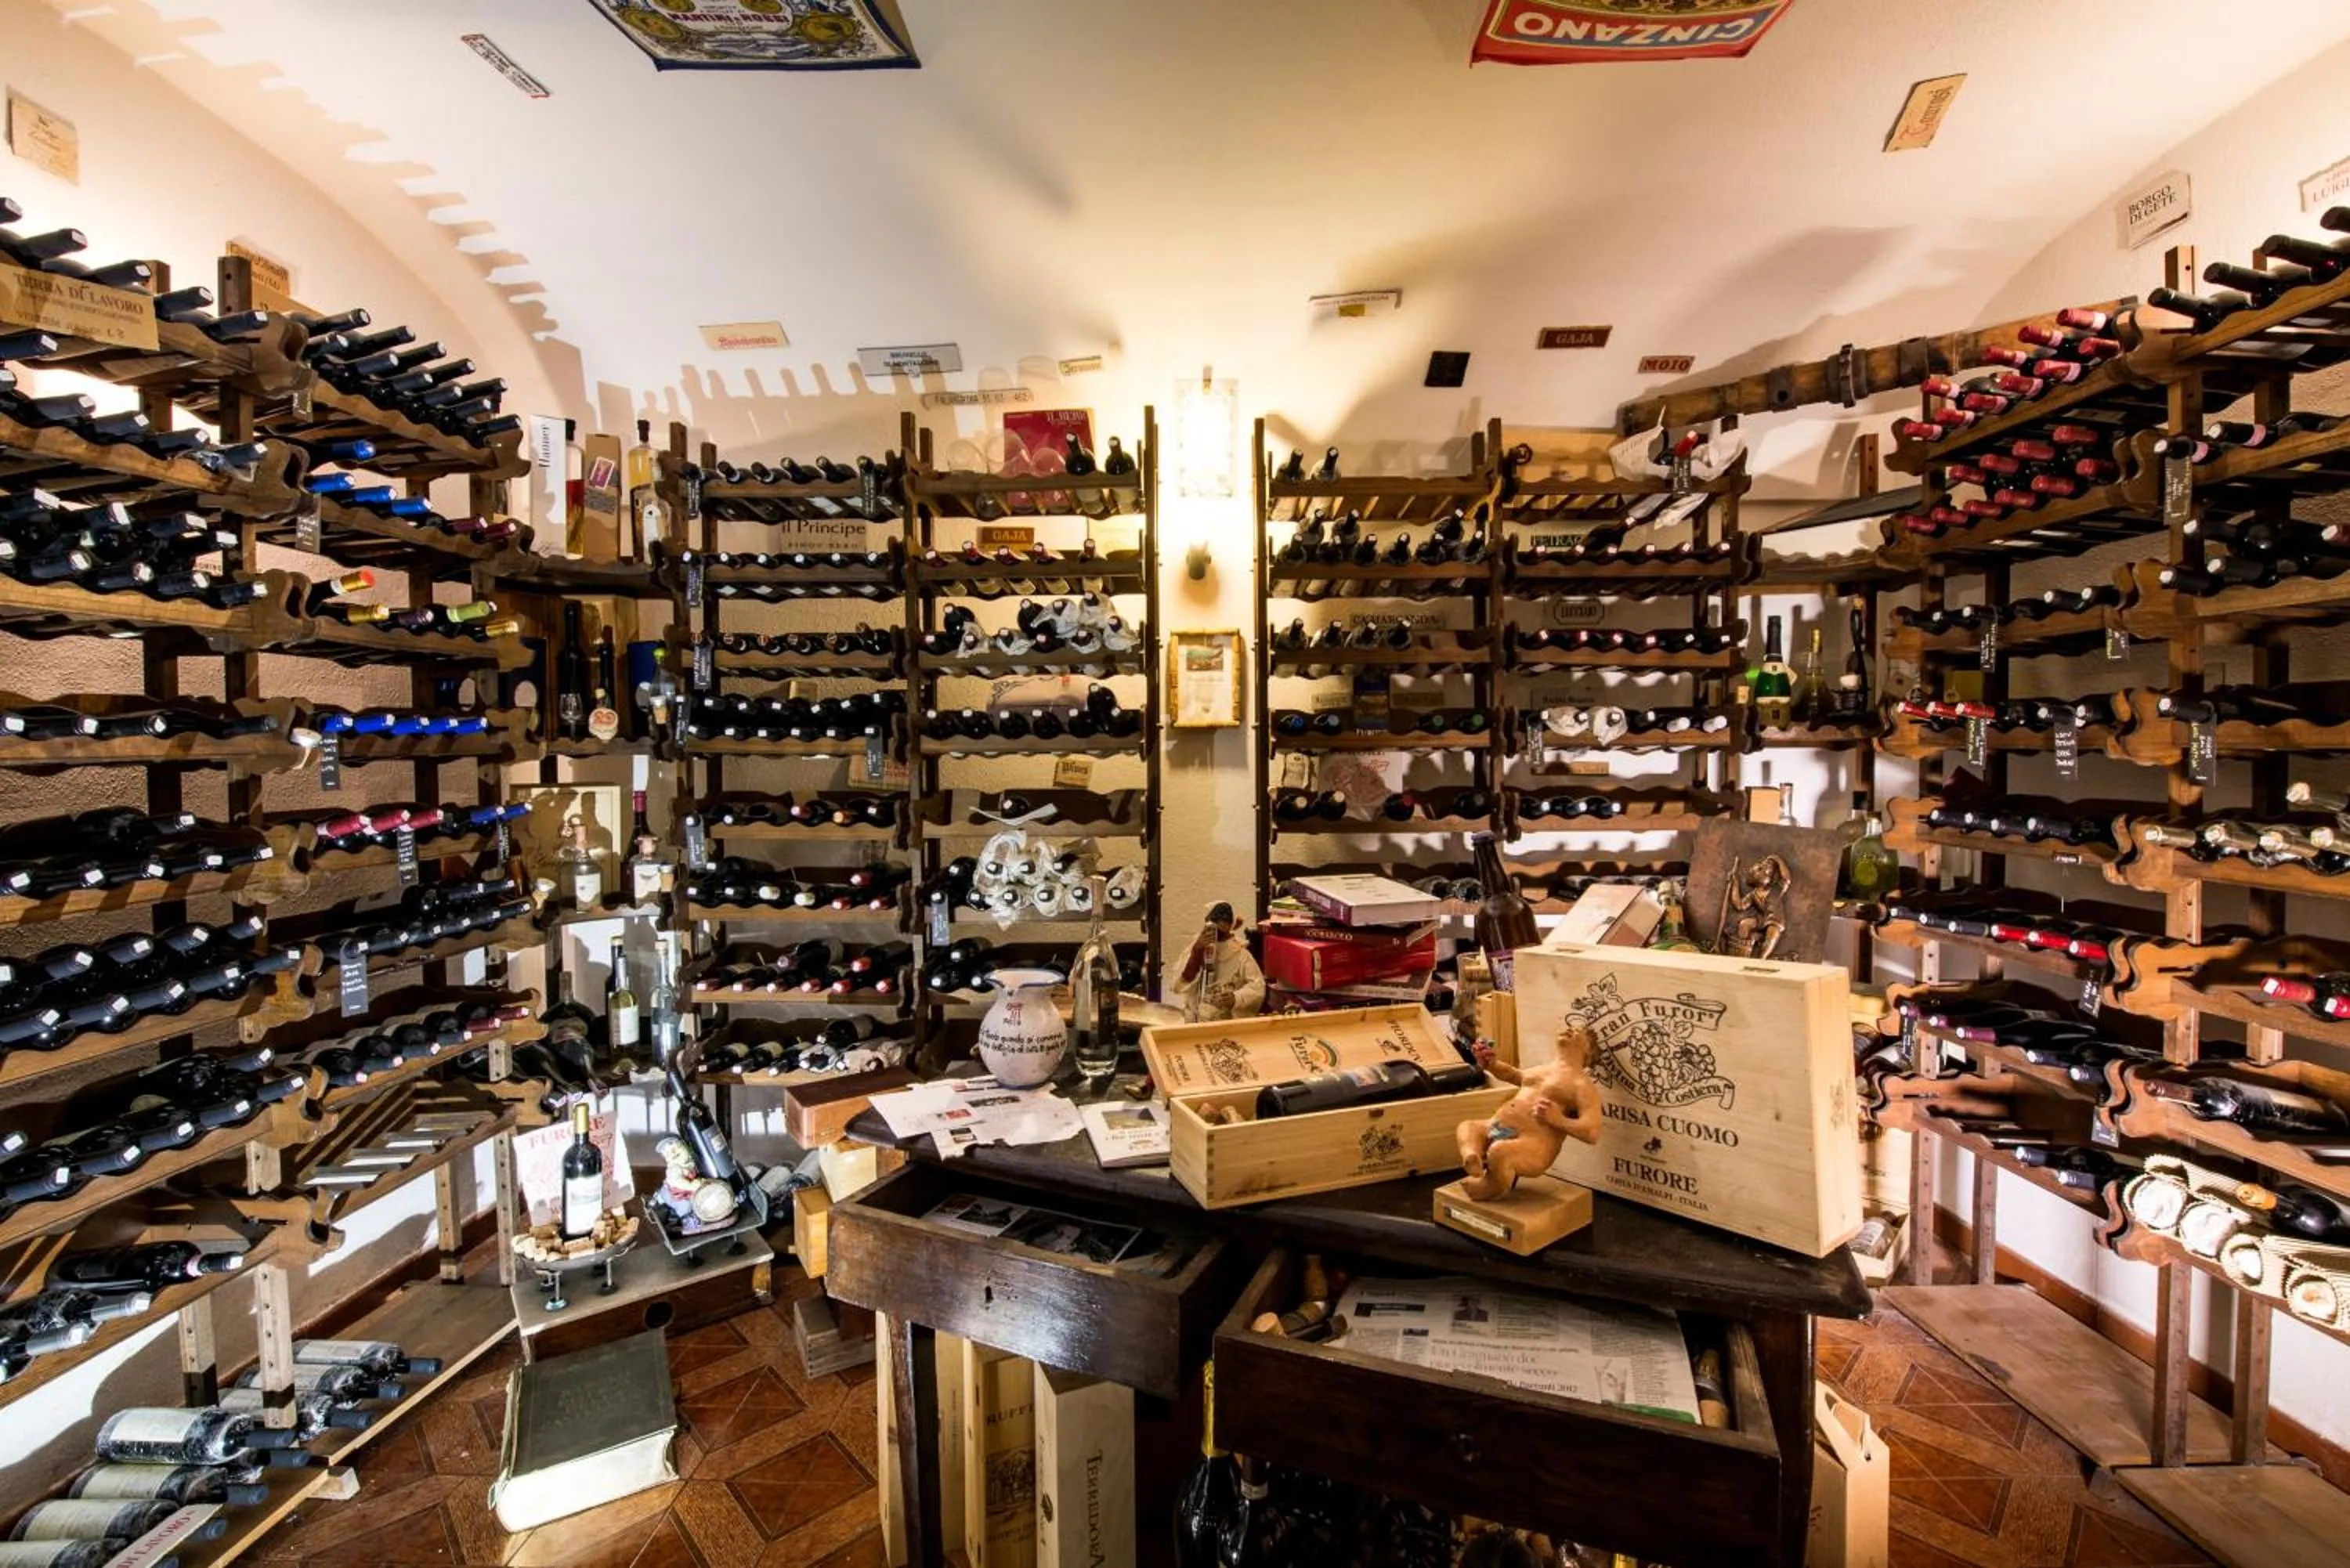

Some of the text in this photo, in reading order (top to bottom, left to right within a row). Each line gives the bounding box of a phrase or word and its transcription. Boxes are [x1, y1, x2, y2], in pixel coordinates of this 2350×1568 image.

[667, 13, 734, 23] MARTINI
[739, 13, 790, 23] ROSSI
[1513, 13, 1754, 45] CINZANO
[2128, 185, 2171, 215] BORGO
[13, 272, 64, 295] TERRA
[88, 292, 144, 315] LAVORO
[1556, 333, 1595, 345] GAJA
[796, 519, 866, 538] Principe
[992, 529, 1027, 540] GAJA
[1600, 1012, 1630, 1037] ran
[1665, 1083, 1722, 1104] Costiera
[1600, 1102, 1739, 1147] ARISA CUOMO
[1614, 1157, 1698, 1195] FURORE
[1678, 1197, 1709, 1211] ITALIA
